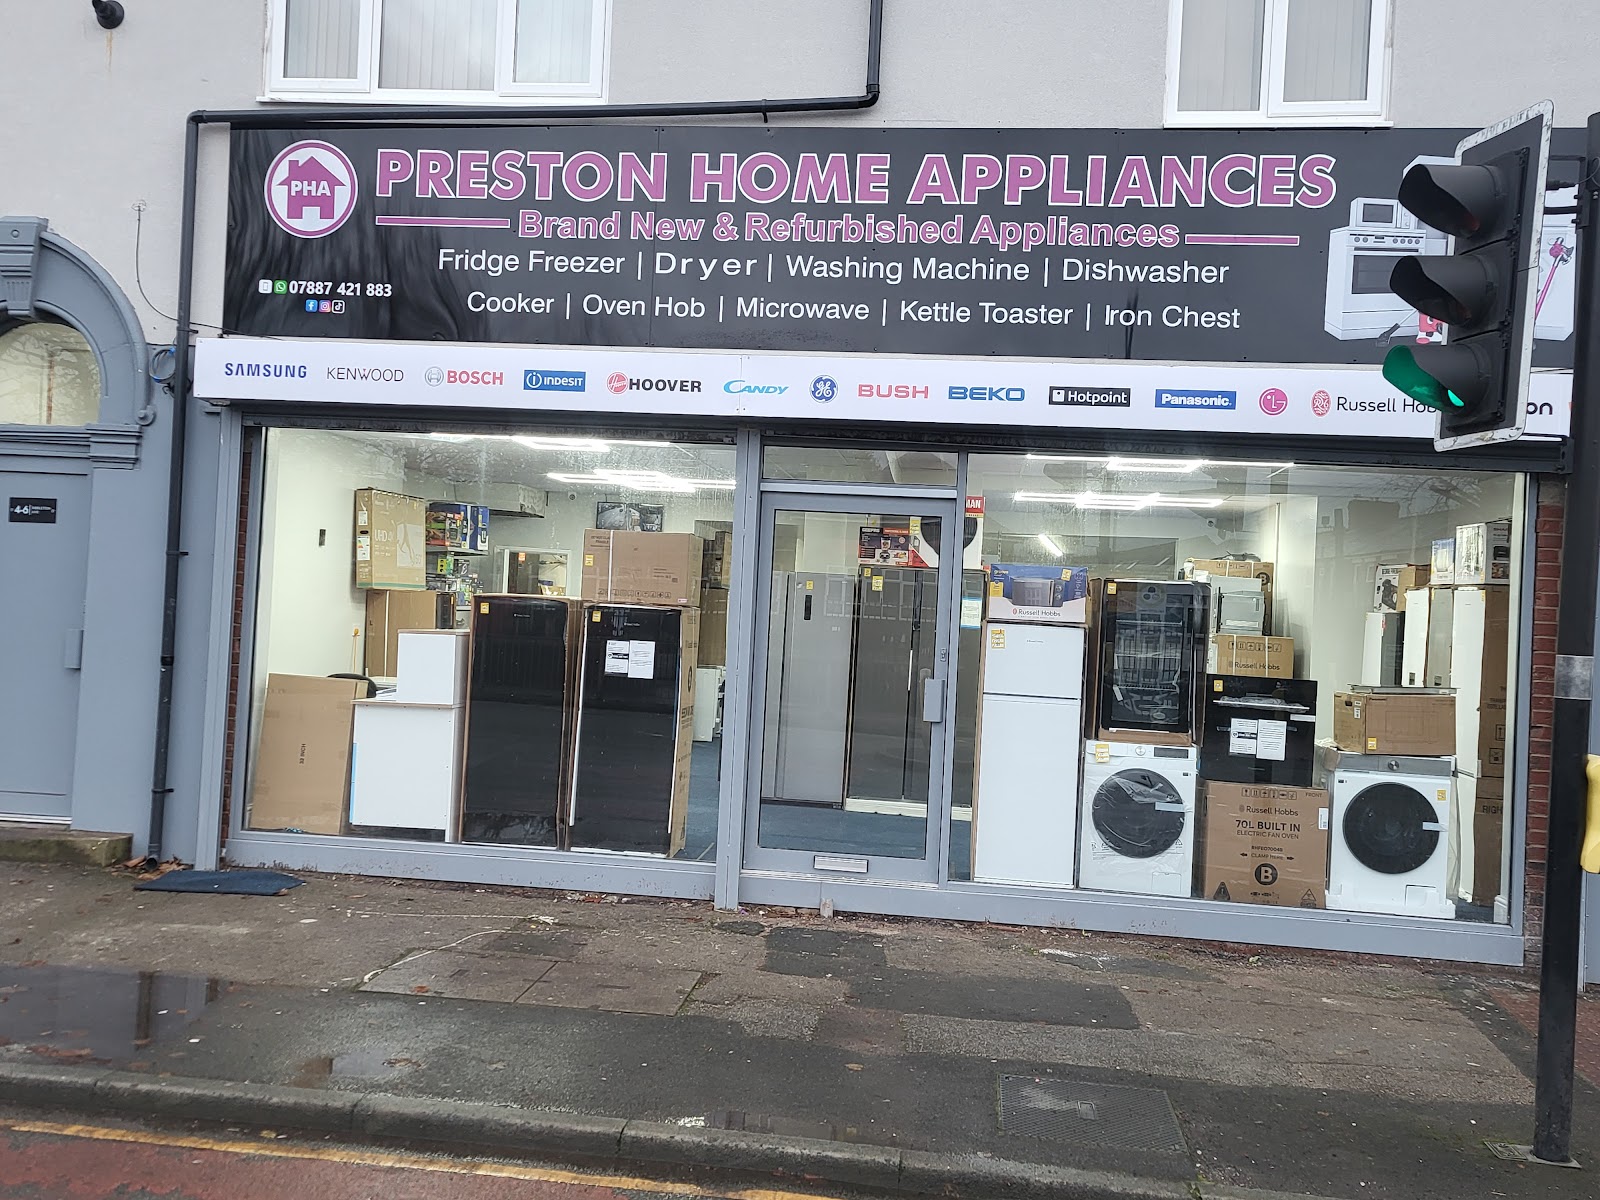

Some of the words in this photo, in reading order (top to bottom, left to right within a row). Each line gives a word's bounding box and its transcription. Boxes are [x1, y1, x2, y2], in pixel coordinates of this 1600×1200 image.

[376, 149, 667, 202] PRESTON
[690, 152, 890, 204] HOME
[906, 154, 1337, 208] APPLIANCES
[290, 180, 332, 197] PHA
[518, 210, 621, 240] Brand
[630, 211, 705, 242] New
[713, 212, 739, 242] &
[745, 213, 963, 245] Refurbished
[969, 215, 1180, 252] Appliances
[439, 249, 519, 276] Fridge
[529, 250, 625, 274] Freezer
[656, 252, 757, 281] Dryer
[786, 255, 902, 284] Washing
[913, 257, 1029, 281] Machine
[1063, 258, 1229, 284] Dishwasher
[289, 280, 333, 295] 07887
[337, 281, 361, 296] 421
[366, 282, 392, 297] 883
[467, 291, 554, 314] Cooker
[583, 294, 646, 316] Oven
[655, 296, 705, 318] Hob
[737, 297, 869, 320] Microwave
[900, 300, 970, 323] Kettle
[979, 302, 1073, 325] Toaster
[1105, 304, 1152, 327] Iron
[1162, 306, 1240, 329] Chest
[224, 362, 307, 379] SAMSUNG
[327, 367, 404, 382] KENWOOD
[447, 369, 504, 386] BOSCH
[629, 378, 702, 393] HOOVER
[724, 379, 789, 395] CANDY
[858, 384, 929, 399] BUSH
[948, 386, 1026, 402] BEKO
[1068, 390, 1128, 406] Hotpoint
[1161, 393, 1230, 407] Panasonic
[1260, 389, 1286, 414] LG
[1337, 396, 1396, 413] Russell
[1526, 402, 1553, 415] on
[1018, 608, 1040, 616] Russell
[1234, 661, 1258, 669] Russell
[1246, 805, 1273, 815] Russell
[1274, 807, 1299, 816] Hobbs
[1235, 819, 1255, 829] 70L
[1257, 821, 1287, 831] BUILT
[1289, 823, 1301, 832] IN
[1236, 829, 1267, 838] ELECTRIC
[1281, 832, 1299, 840] OVEN
